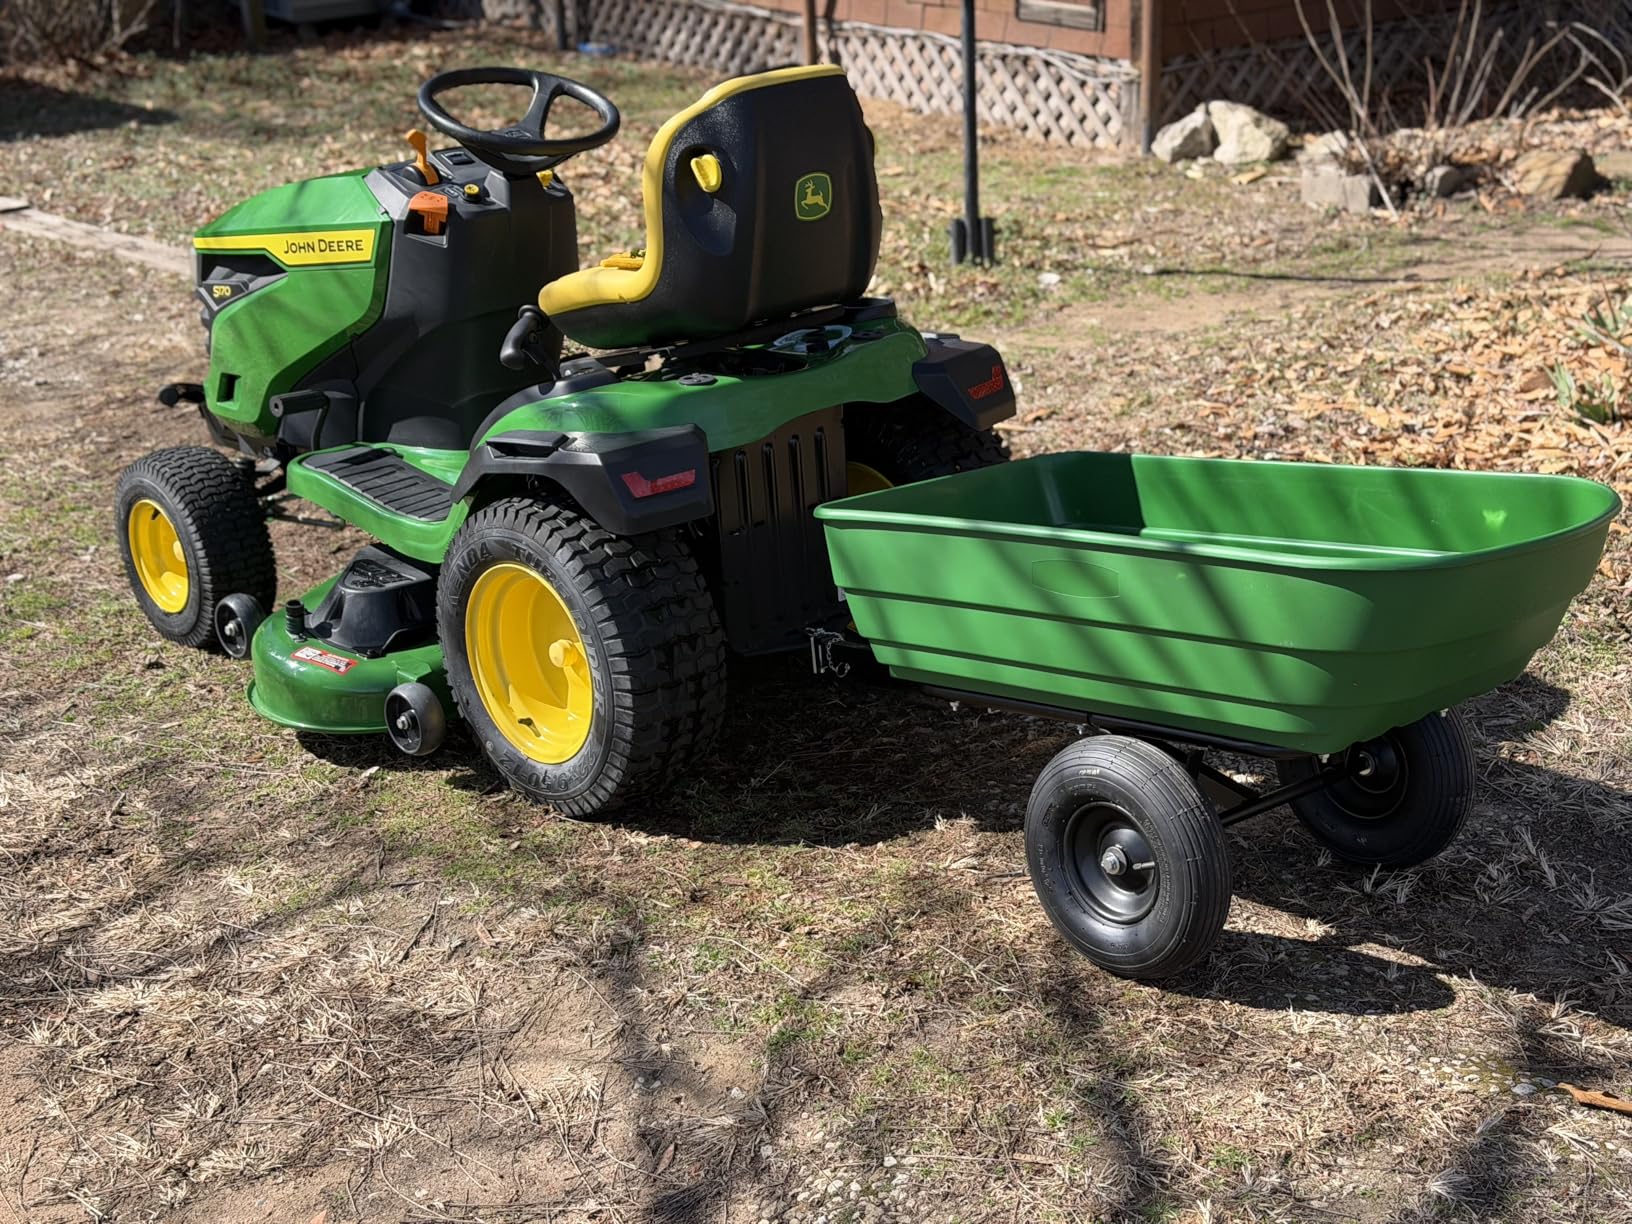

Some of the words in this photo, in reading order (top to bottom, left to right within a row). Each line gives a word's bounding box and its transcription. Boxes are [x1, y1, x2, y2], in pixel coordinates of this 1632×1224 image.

[284, 240, 315, 255] JOHN
[318, 239, 364, 252] DEERE
[213, 285, 231, 298] S170
[572, 609, 607, 716] RIDER
